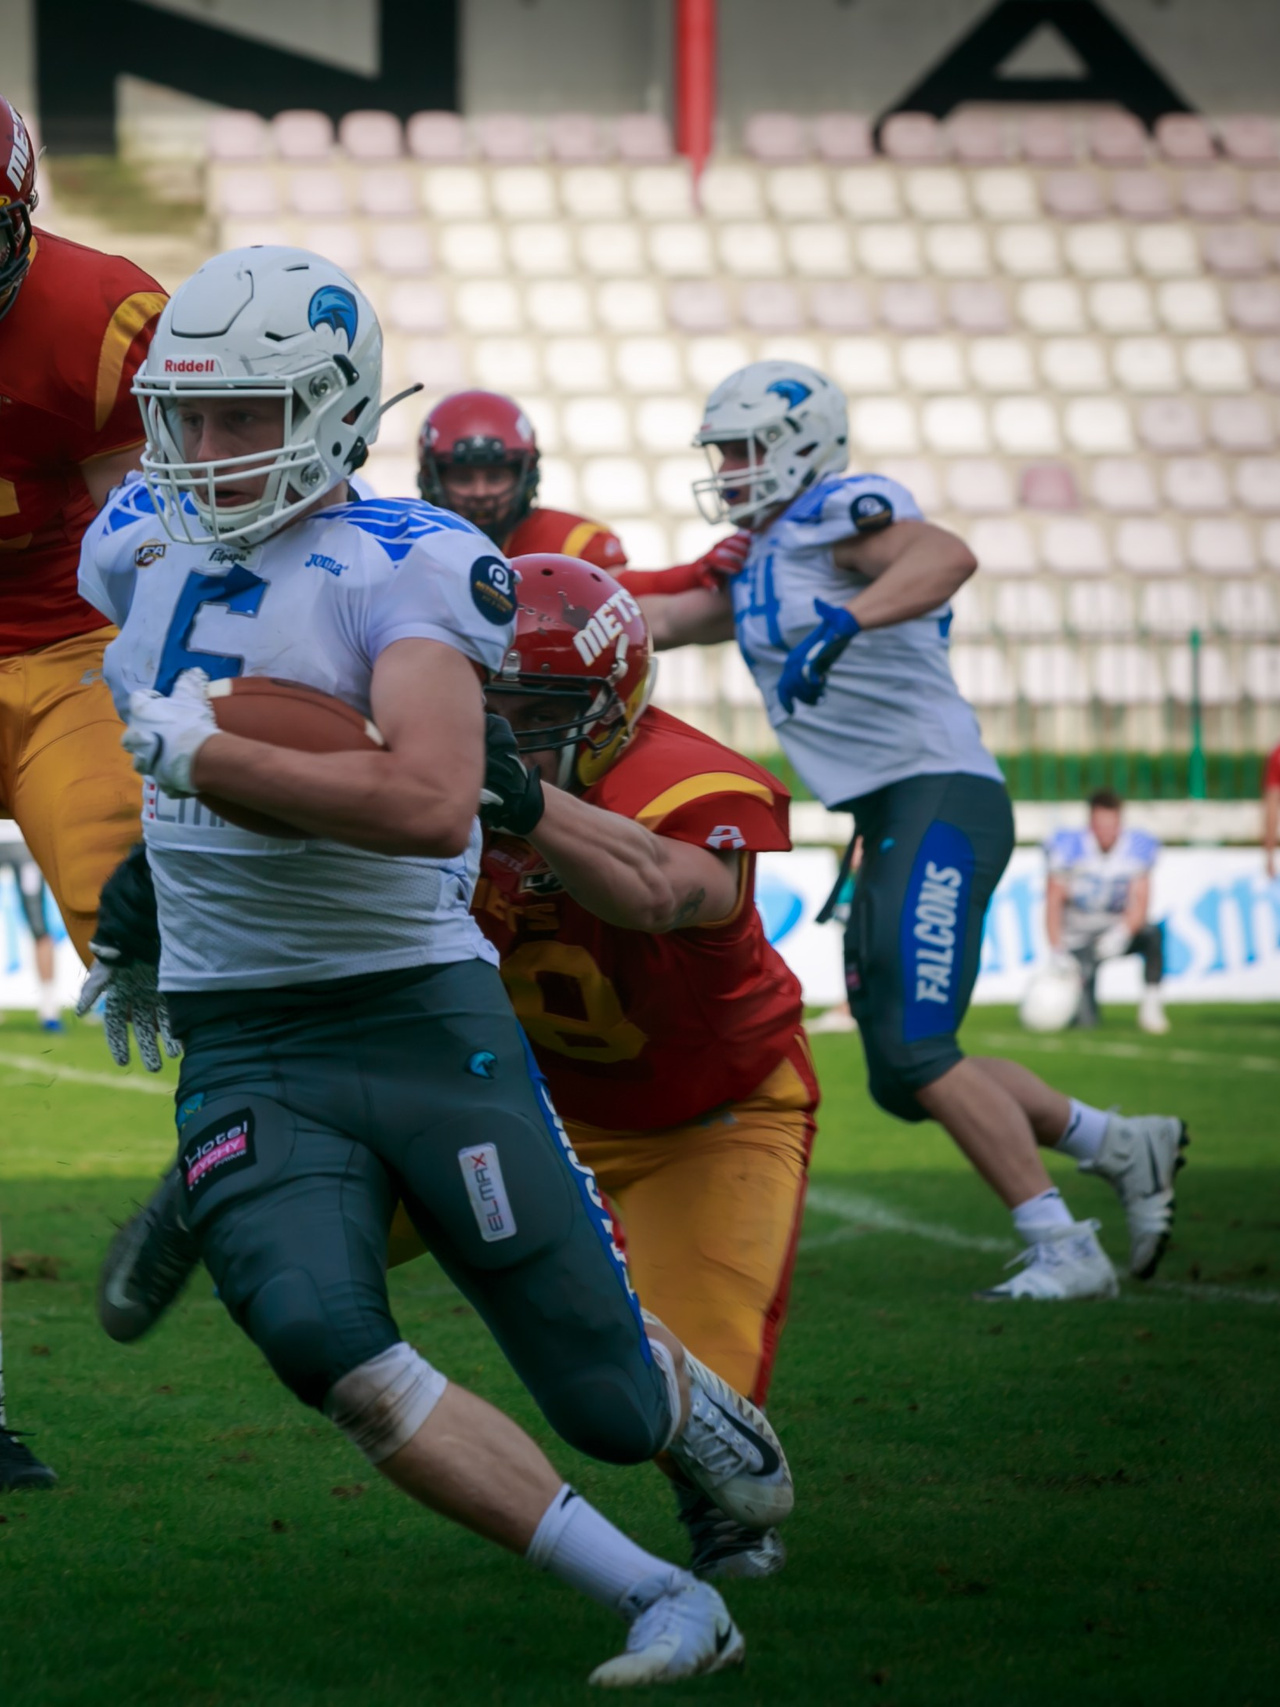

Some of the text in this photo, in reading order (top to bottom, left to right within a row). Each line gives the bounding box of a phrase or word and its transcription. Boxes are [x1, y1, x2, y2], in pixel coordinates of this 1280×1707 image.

[165, 359, 215, 373] Riddell
[913, 861, 962, 1005] FALCONS
[185, 1120, 248, 1169] Hotel
[470, 1152, 505, 1232] ELMAX
